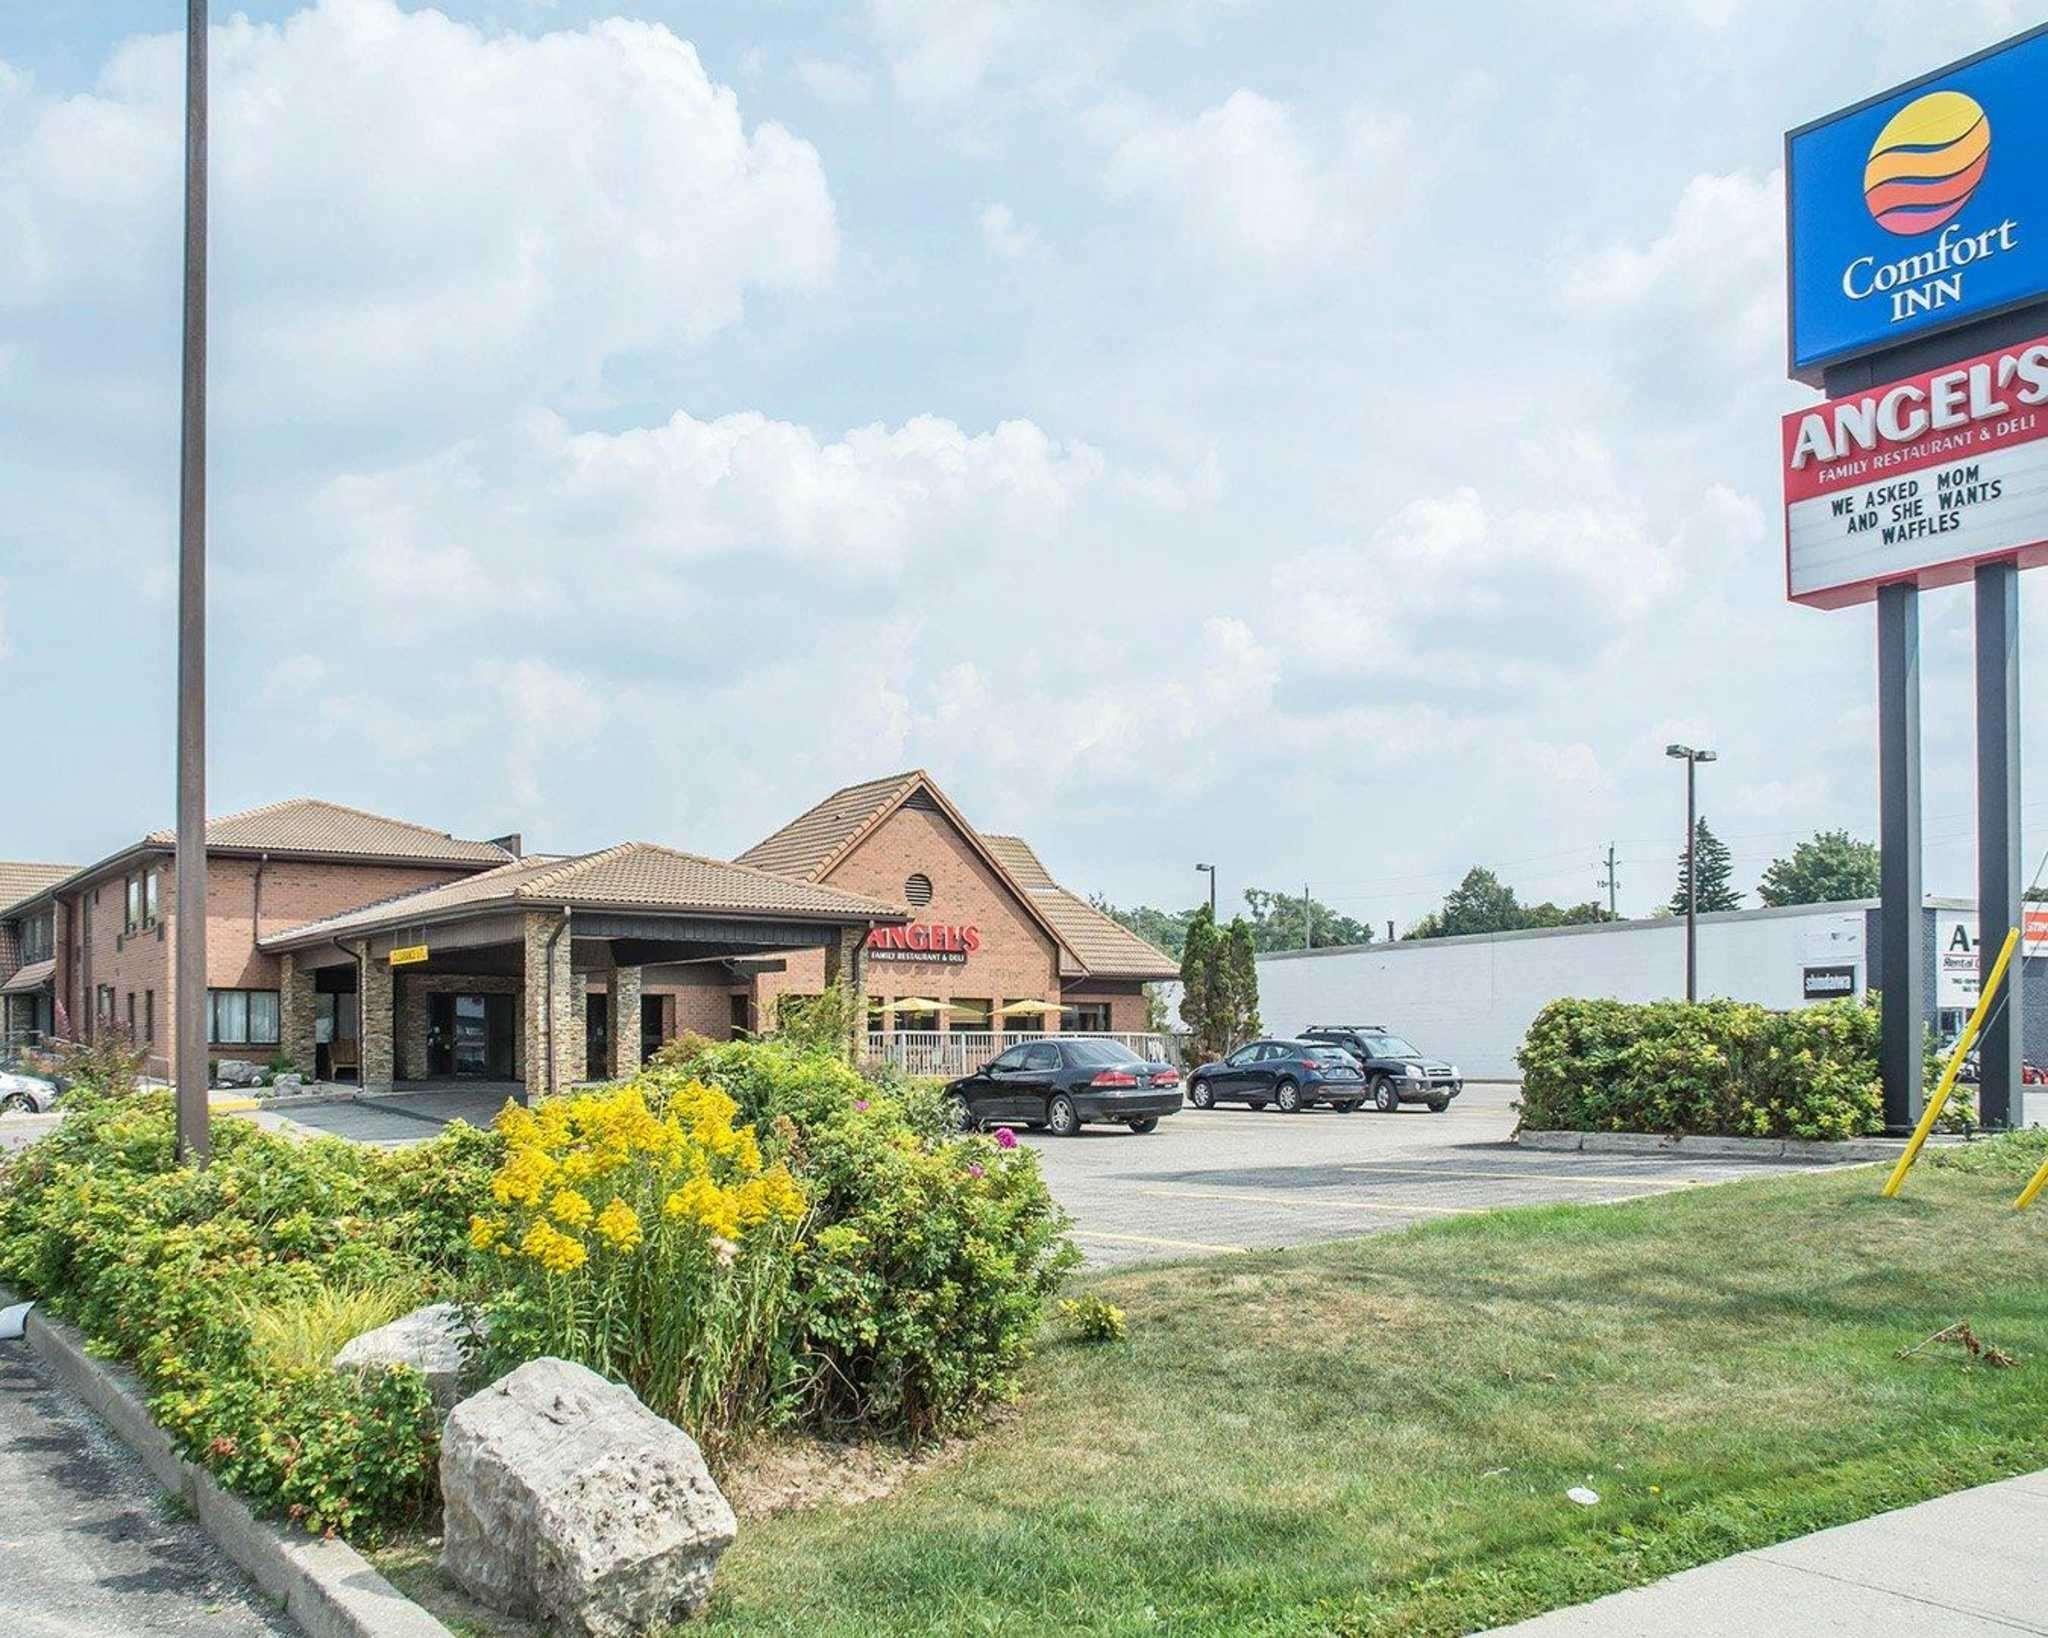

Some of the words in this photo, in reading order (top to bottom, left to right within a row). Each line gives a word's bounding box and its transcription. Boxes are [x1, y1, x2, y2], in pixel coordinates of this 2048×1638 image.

[1842, 218, 2018, 299] Comfort
[1890, 272, 1962, 323] INN
[1790, 345, 2048, 470] ANGEL'S
[1818, 458, 1868, 484] FAMILY
[1873, 430, 1974, 470] RESTAURANT
[1979, 427, 1991, 442] &
[1996, 414, 2036, 437] DELI
[1831, 496, 1854, 517] WE
[1865, 480, 1919, 509] ASKED
[1937, 464, 1980, 491] MOM
[1847, 511, 1879, 534] AND
[1891, 499, 1923, 523] SHE
[1938, 479, 2002, 511] WANTS
[1882, 511, 1960, 545] WAFFLES
[866, 924, 982, 954] ANGEL'S
[897, 951, 940, 961] RESTAURANT
